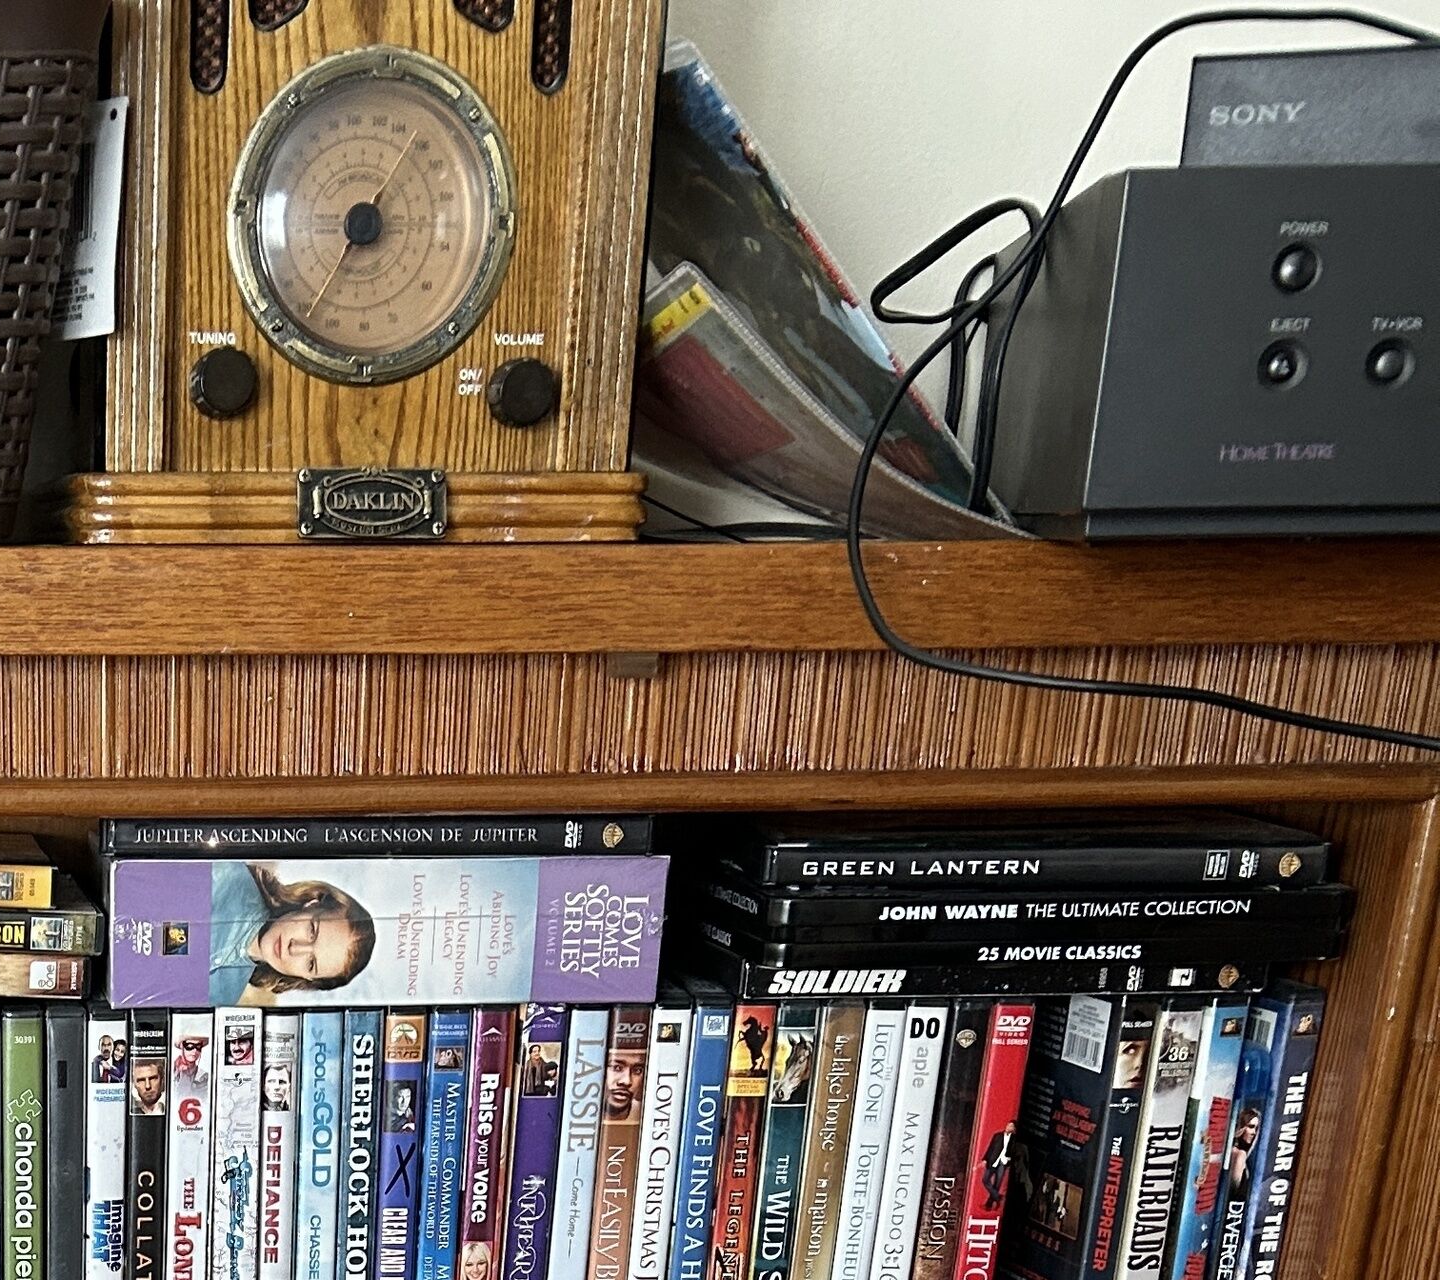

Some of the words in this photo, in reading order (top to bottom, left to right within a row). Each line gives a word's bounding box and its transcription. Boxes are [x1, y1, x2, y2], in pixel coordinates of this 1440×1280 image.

[1209, 103, 1306, 125] SONY
[1280, 221, 1329, 235] POWER
[189, 332, 235, 344] TUNING
[494, 334, 544, 345] VOLUME
[1270, 318, 1311, 332] EJECT
[459, 384, 481, 395] OFF
[1219, 444, 1269, 462] HOME
[1273, 442, 1336, 461] THEATRE
[134, 827, 205, 844] JUPITER
[208, 826, 308, 844] ASCENDING
[324, 827, 434, 844] L'ASCENSION
[440, 827, 464, 844] DE
[471, 827, 538, 844] JUPITER
[803, 861, 895, 877] GREEN
[911, 860, 1040, 875] LANTERN
[879, 906, 940, 922] JOHN
[945, 904, 1018, 920] WAYNE
[1025, 903, 1057, 918] THE
[1061, 901, 1141, 917] ULTIMATE
[1144, 899, 1251, 916] COLLECTION
[560, 891, 587, 973] SERIES
[581, 884, 609, 979] SOFTLY
[602, 895, 623, 967] COMES
[618, 895, 650, 969] LOVE
[977, 947, 1000, 961] 25
[1003, 946, 1061, 962] MOVIE
[1065, 945, 1142, 961] CLASSICS
[768, 970, 907, 993] SOLDIER
[566, 1037, 607, 1153] LASSIE
[1281, 1072, 1308, 1116] THE
[346, 1034, 375, 1219] SHERLOCK
[694, 1085, 721, 1148] LOVE
[1272, 1122, 1299, 1173] WAR
[12, 1122, 35, 1230] chonda
[774, 1155, 790, 1185] THE
[184, 1178, 194, 1209] THE
[262, 1126, 283, 1265] DEFIANCE
[684, 1154, 713, 1231] FINDS
[1126, 1124, 1183, 1272] RAILROADS
[1270, 1178, 1289, 1207] OF
[761, 1191, 791, 1262] WILD
[1258, 1212, 1285, 1255] THE
[684, 1234, 705, 1253] A
